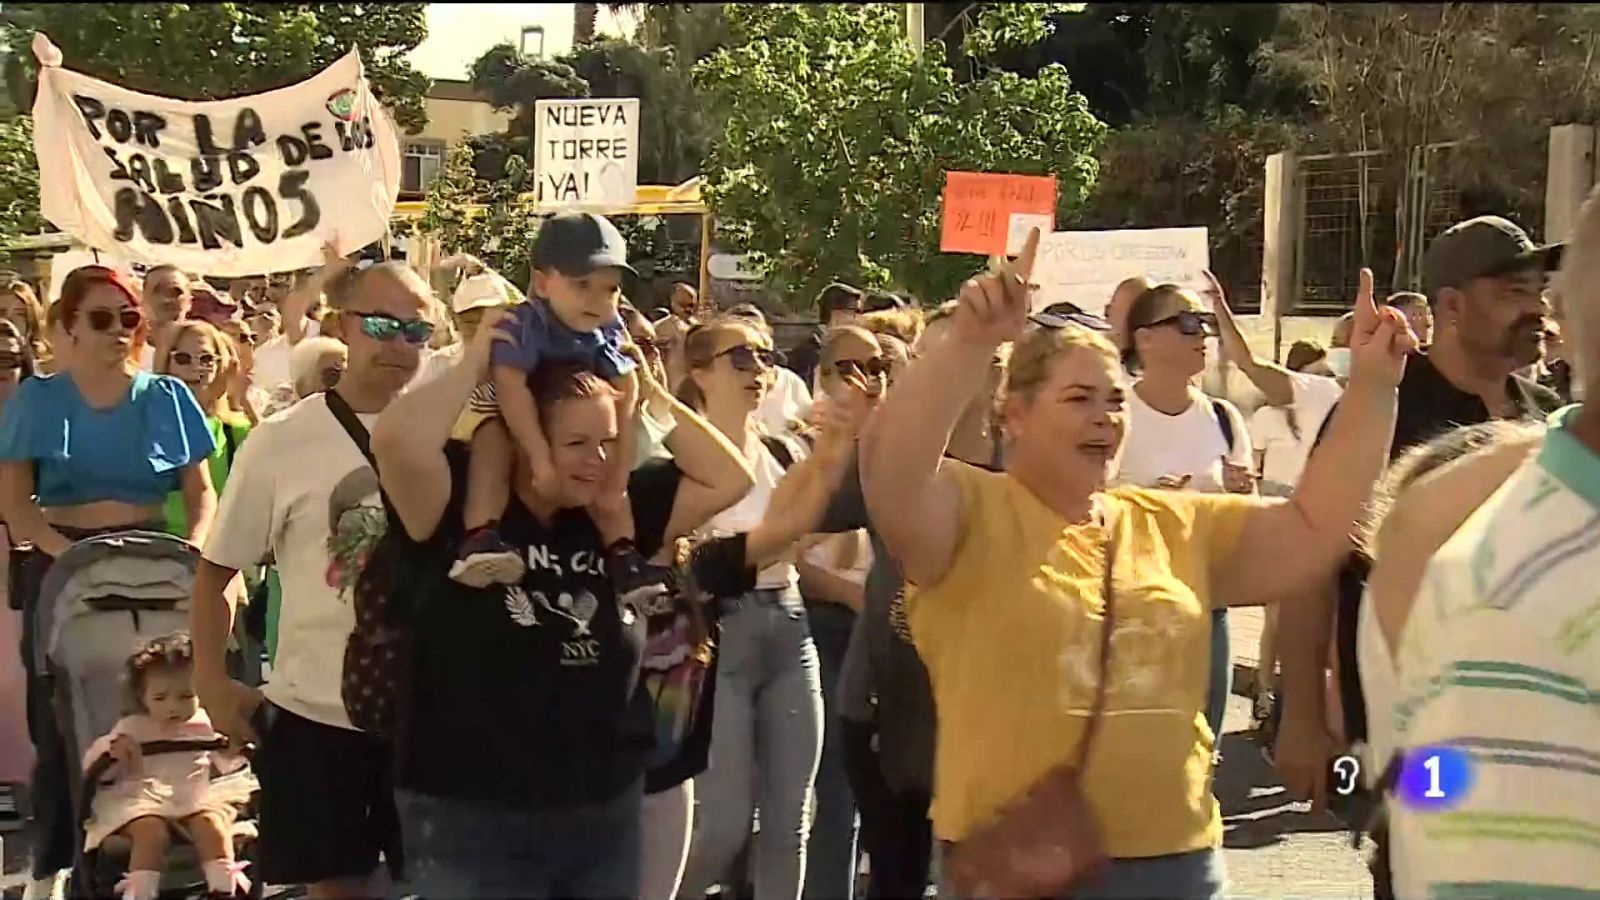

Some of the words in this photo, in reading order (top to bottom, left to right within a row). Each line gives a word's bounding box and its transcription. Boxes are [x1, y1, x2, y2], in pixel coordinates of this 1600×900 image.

[73, 94, 168, 149] POR
[193, 107, 267, 155] LA
[546, 104, 627, 127] NUEVA
[102, 146, 261, 193] SALUD
[276, 121, 334, 167] DE
[546, 137, 628, 160] TORRE
[561, 639, 600, 658] NYC
